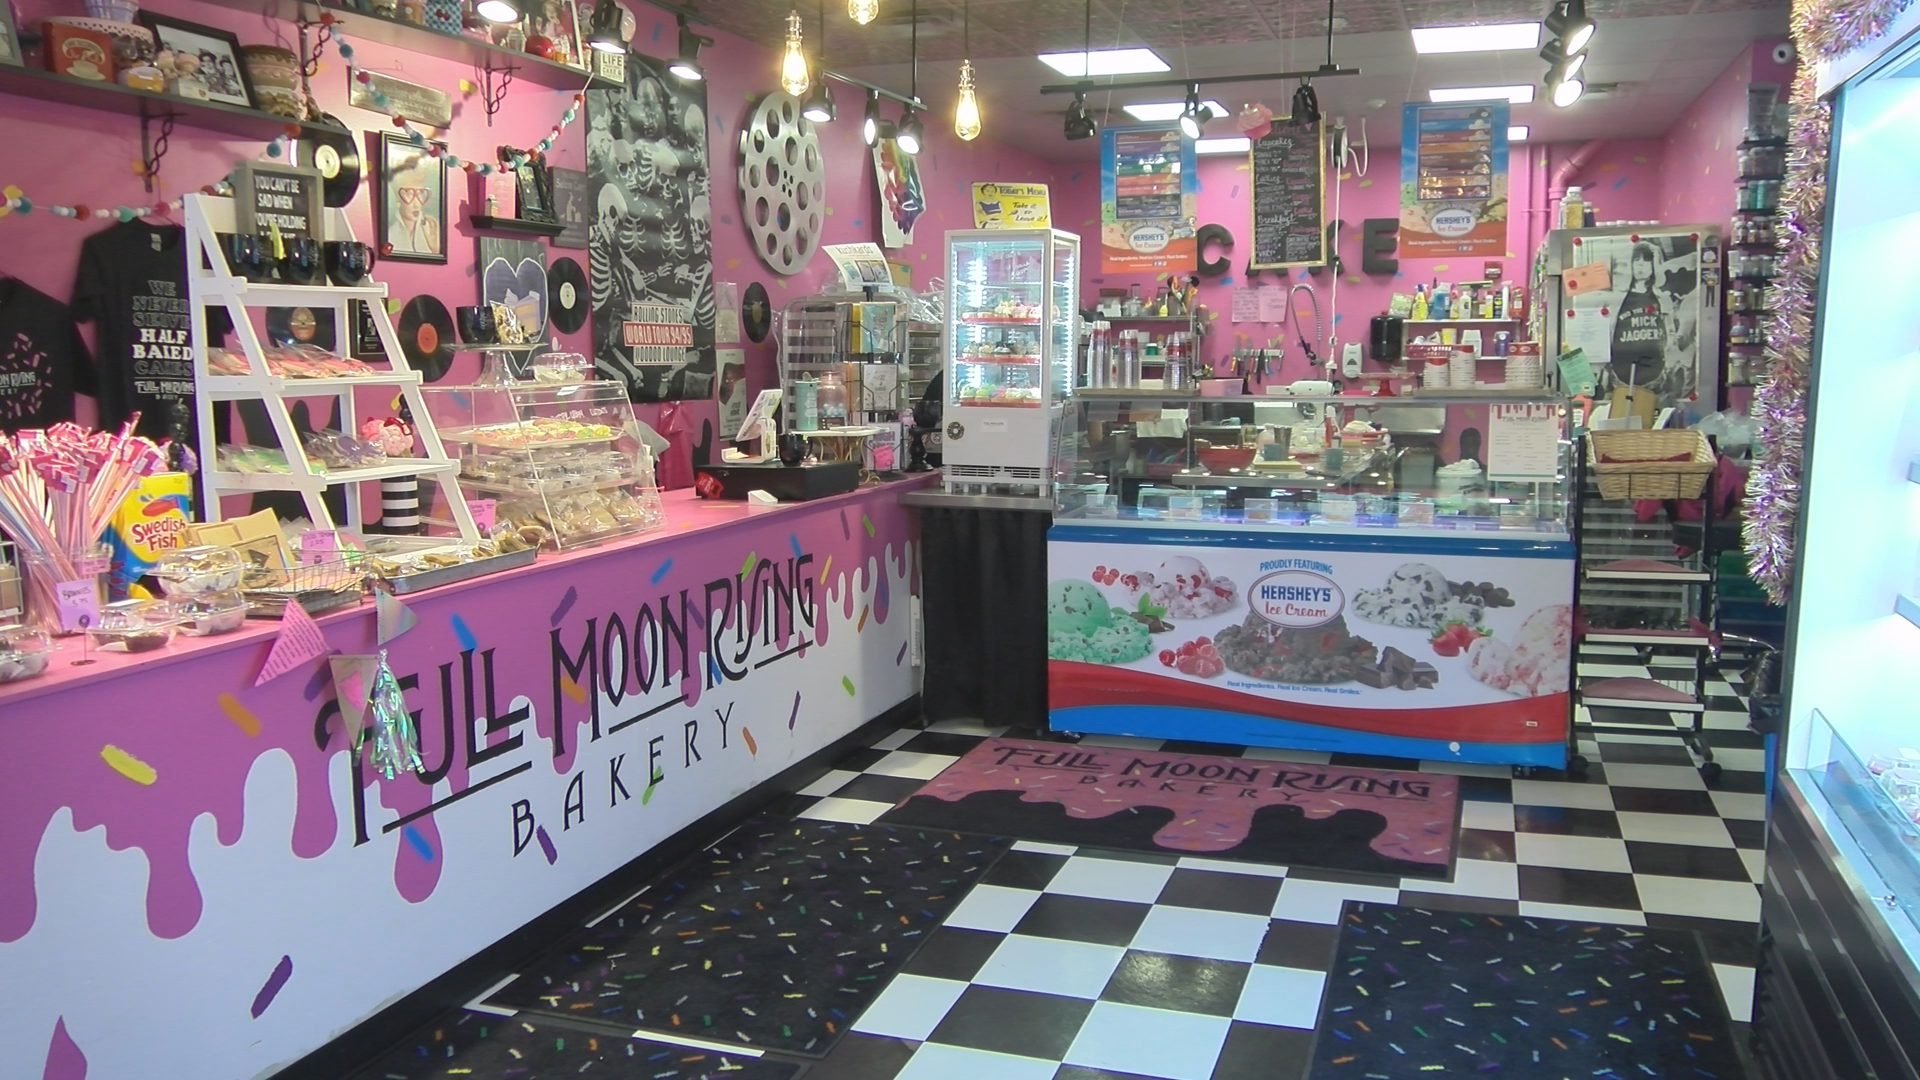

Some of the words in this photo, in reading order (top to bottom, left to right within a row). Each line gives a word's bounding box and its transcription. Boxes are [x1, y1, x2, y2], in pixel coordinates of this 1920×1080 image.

[602, 53, 623, 67] LIFE
[254, 174, 272, 191] YOU
[290, 179, 300, 194] BE
[257, 192, 273, 208] SAD
[272, 194, 294, 210] WHEN
[277, 214, 307, 231] HOLDING
[1435, 215, 1471, 225] HERSHEY'S
[1133, 233, 1165, 241] HERSHEY'S
[147, 280, 176, 297] WE
[633, 305, 659, 323] ROLLING
[660, 307, 683, 324] STONES
[1631, 316, 1658, 328] MICK
[140, 328, 187, 344] HALF
[625, 324, 653, 344] WORLD
[652, 325, 671, 344] TOUR
[670, 326, 692, 345] 94/95
[131, 516, 186, 544] Swedish
[146, 532, 177, 552] Fish
[1259, 558, 1293, 572] PROUDLY
[1294, 558, 1333, 575] FEATURING
[1261, 584, 1332, 603] HERSHEY'S
[1265, 601, 1282, 615] Ice
[1285, 602, 1328, 618] Cream
[1241, 681, 1276, 690] Ingredients.
[316, 648, 531, 847] FULL
[549, 589, 692, 758] MOON
[704, 553, 814, 692] RISING
[511, 701, 735, 858] BAKERY
[993, 747, 1109, 768] FULL
[1120, 758, 1261, 784] MOON
[1270, 770, 1430, 798] RISING
[1078, 775, 1304, 802] BAKERY
